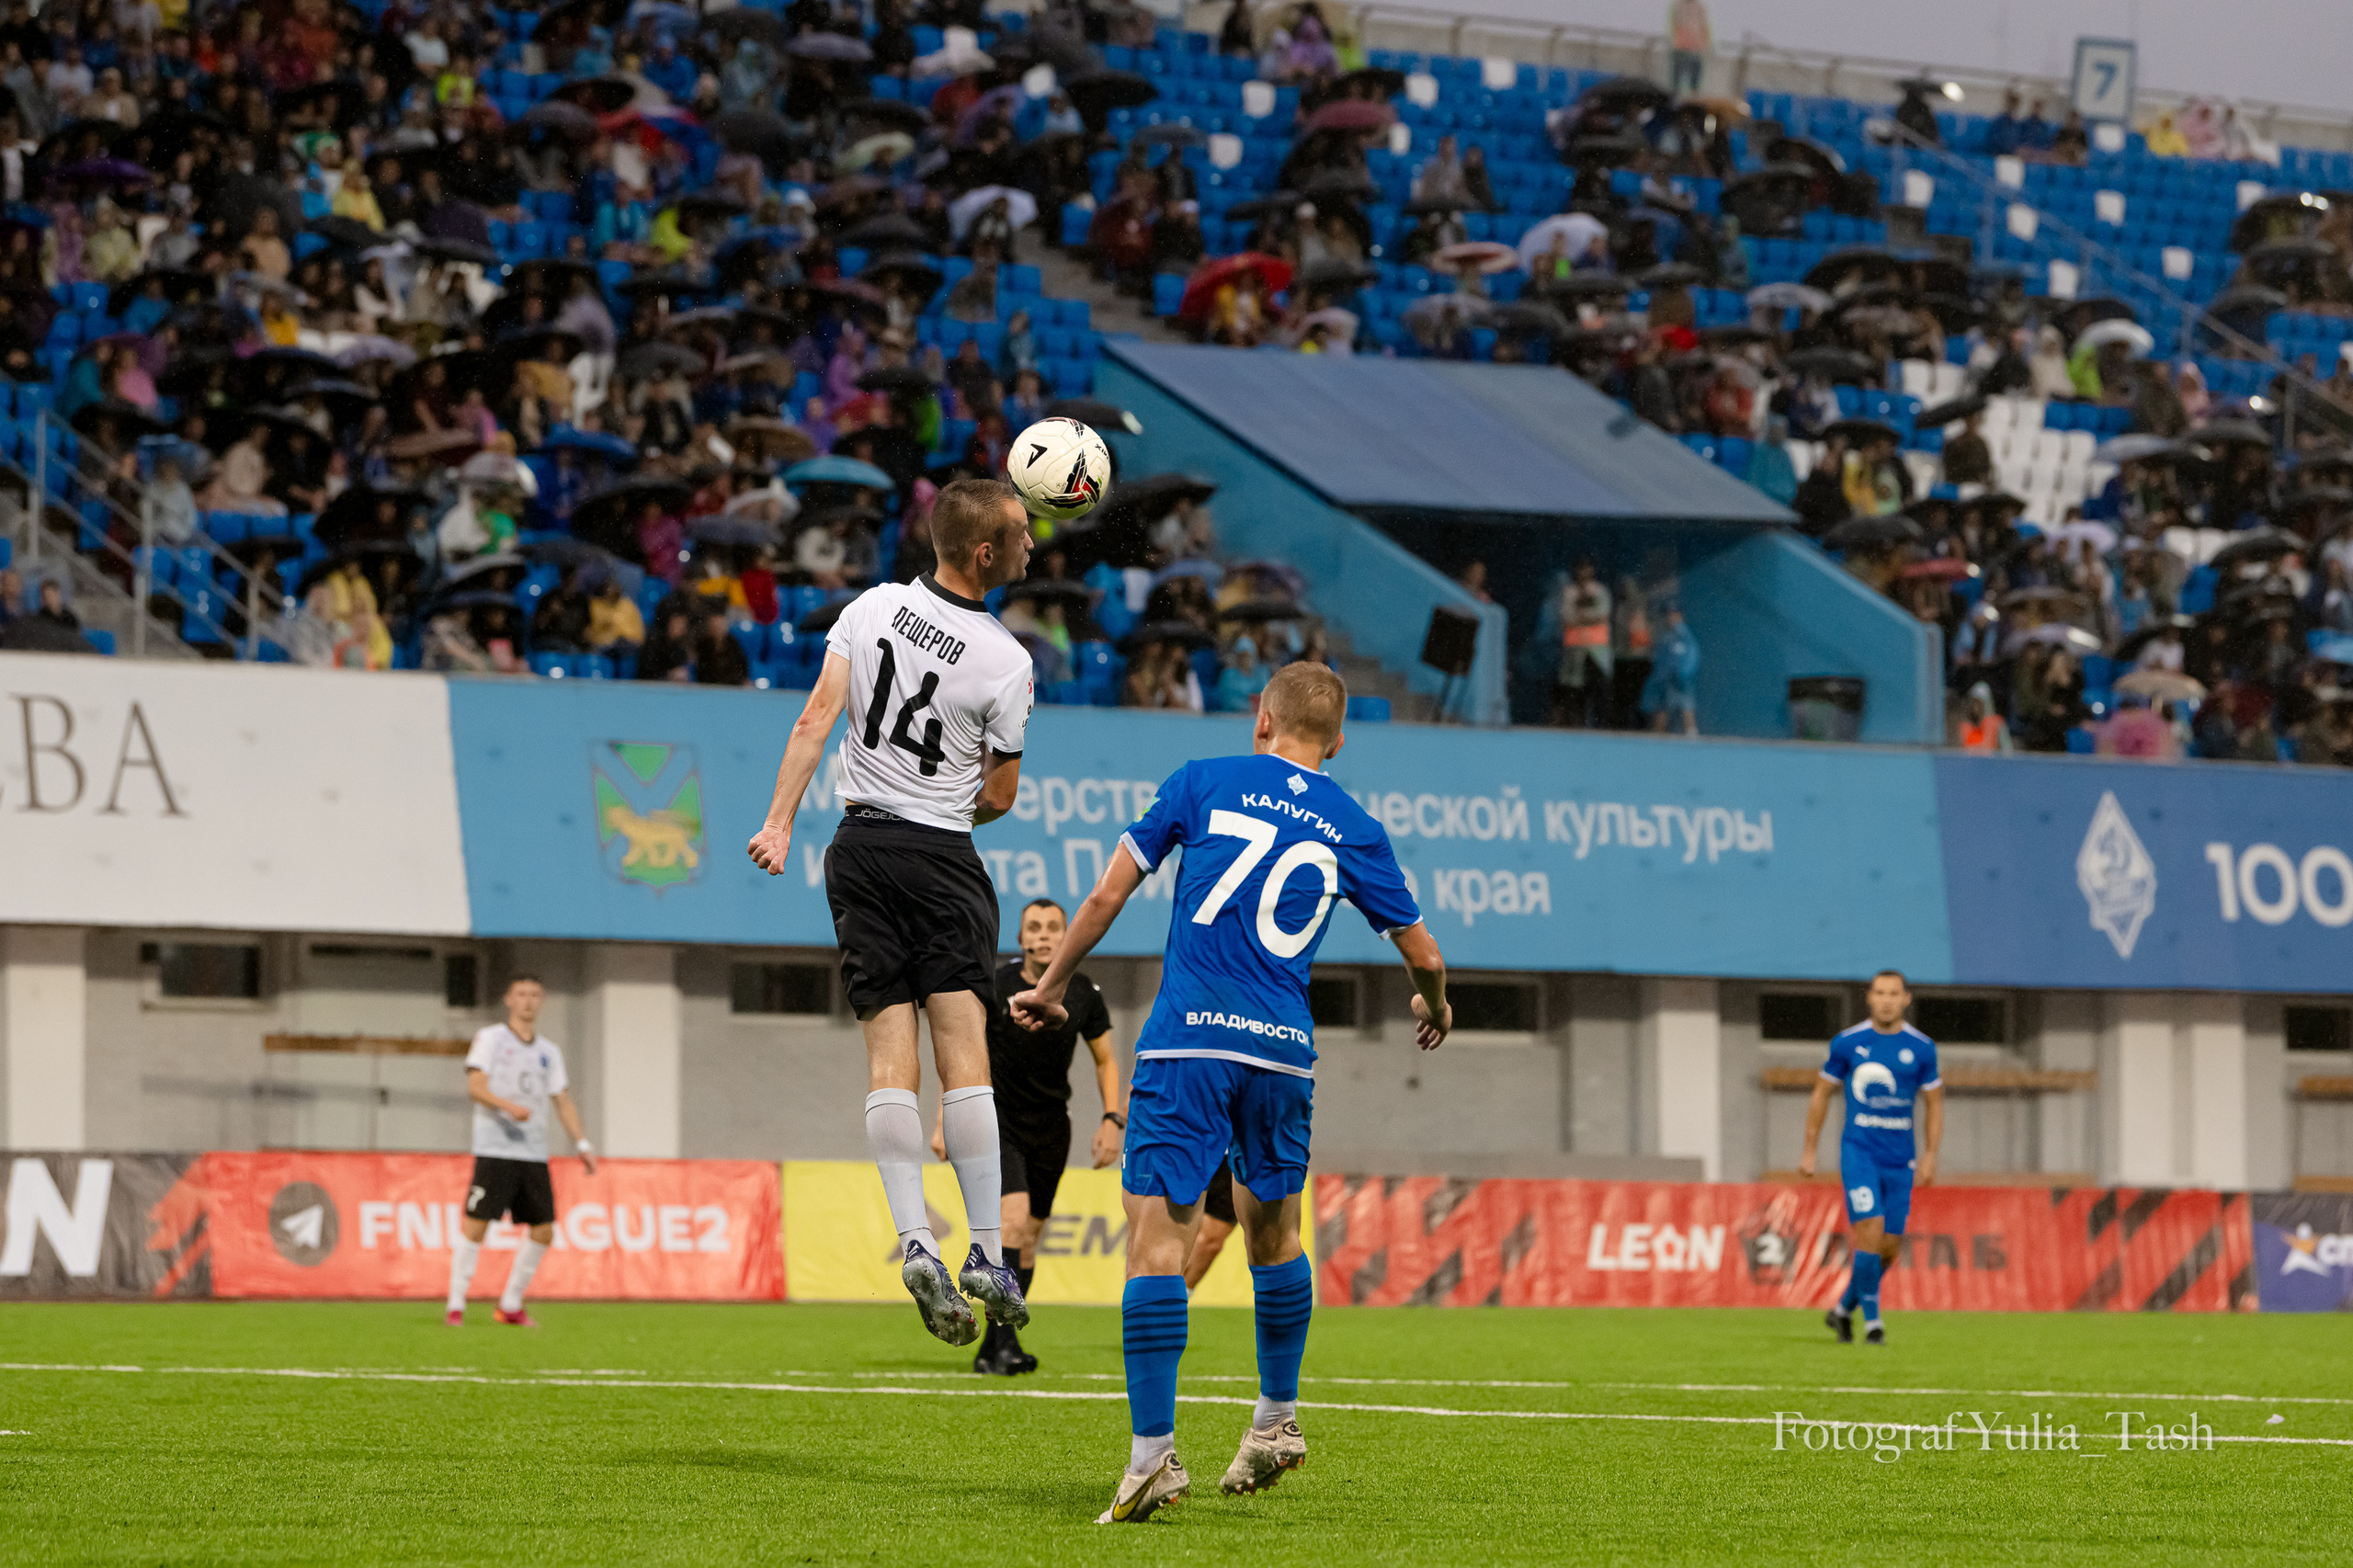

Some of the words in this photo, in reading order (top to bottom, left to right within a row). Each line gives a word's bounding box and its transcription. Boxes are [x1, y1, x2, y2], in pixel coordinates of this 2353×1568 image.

[2094, 62, 2118, 100] 7
[891, 606, 966, 665] ПЕЩЕРОВ
[863, 637, 946, 777] 14
[1242, 793, 1343, 843] КАЛУГИН
[1544, 799, 1774, 864] культуры
[1191, 809, 1338, 959] 70
[1434, 867, 1552, 926] края
[2205, 841, 2353, 927] 100
[1586, 1221, 1727, 1272] LEON
